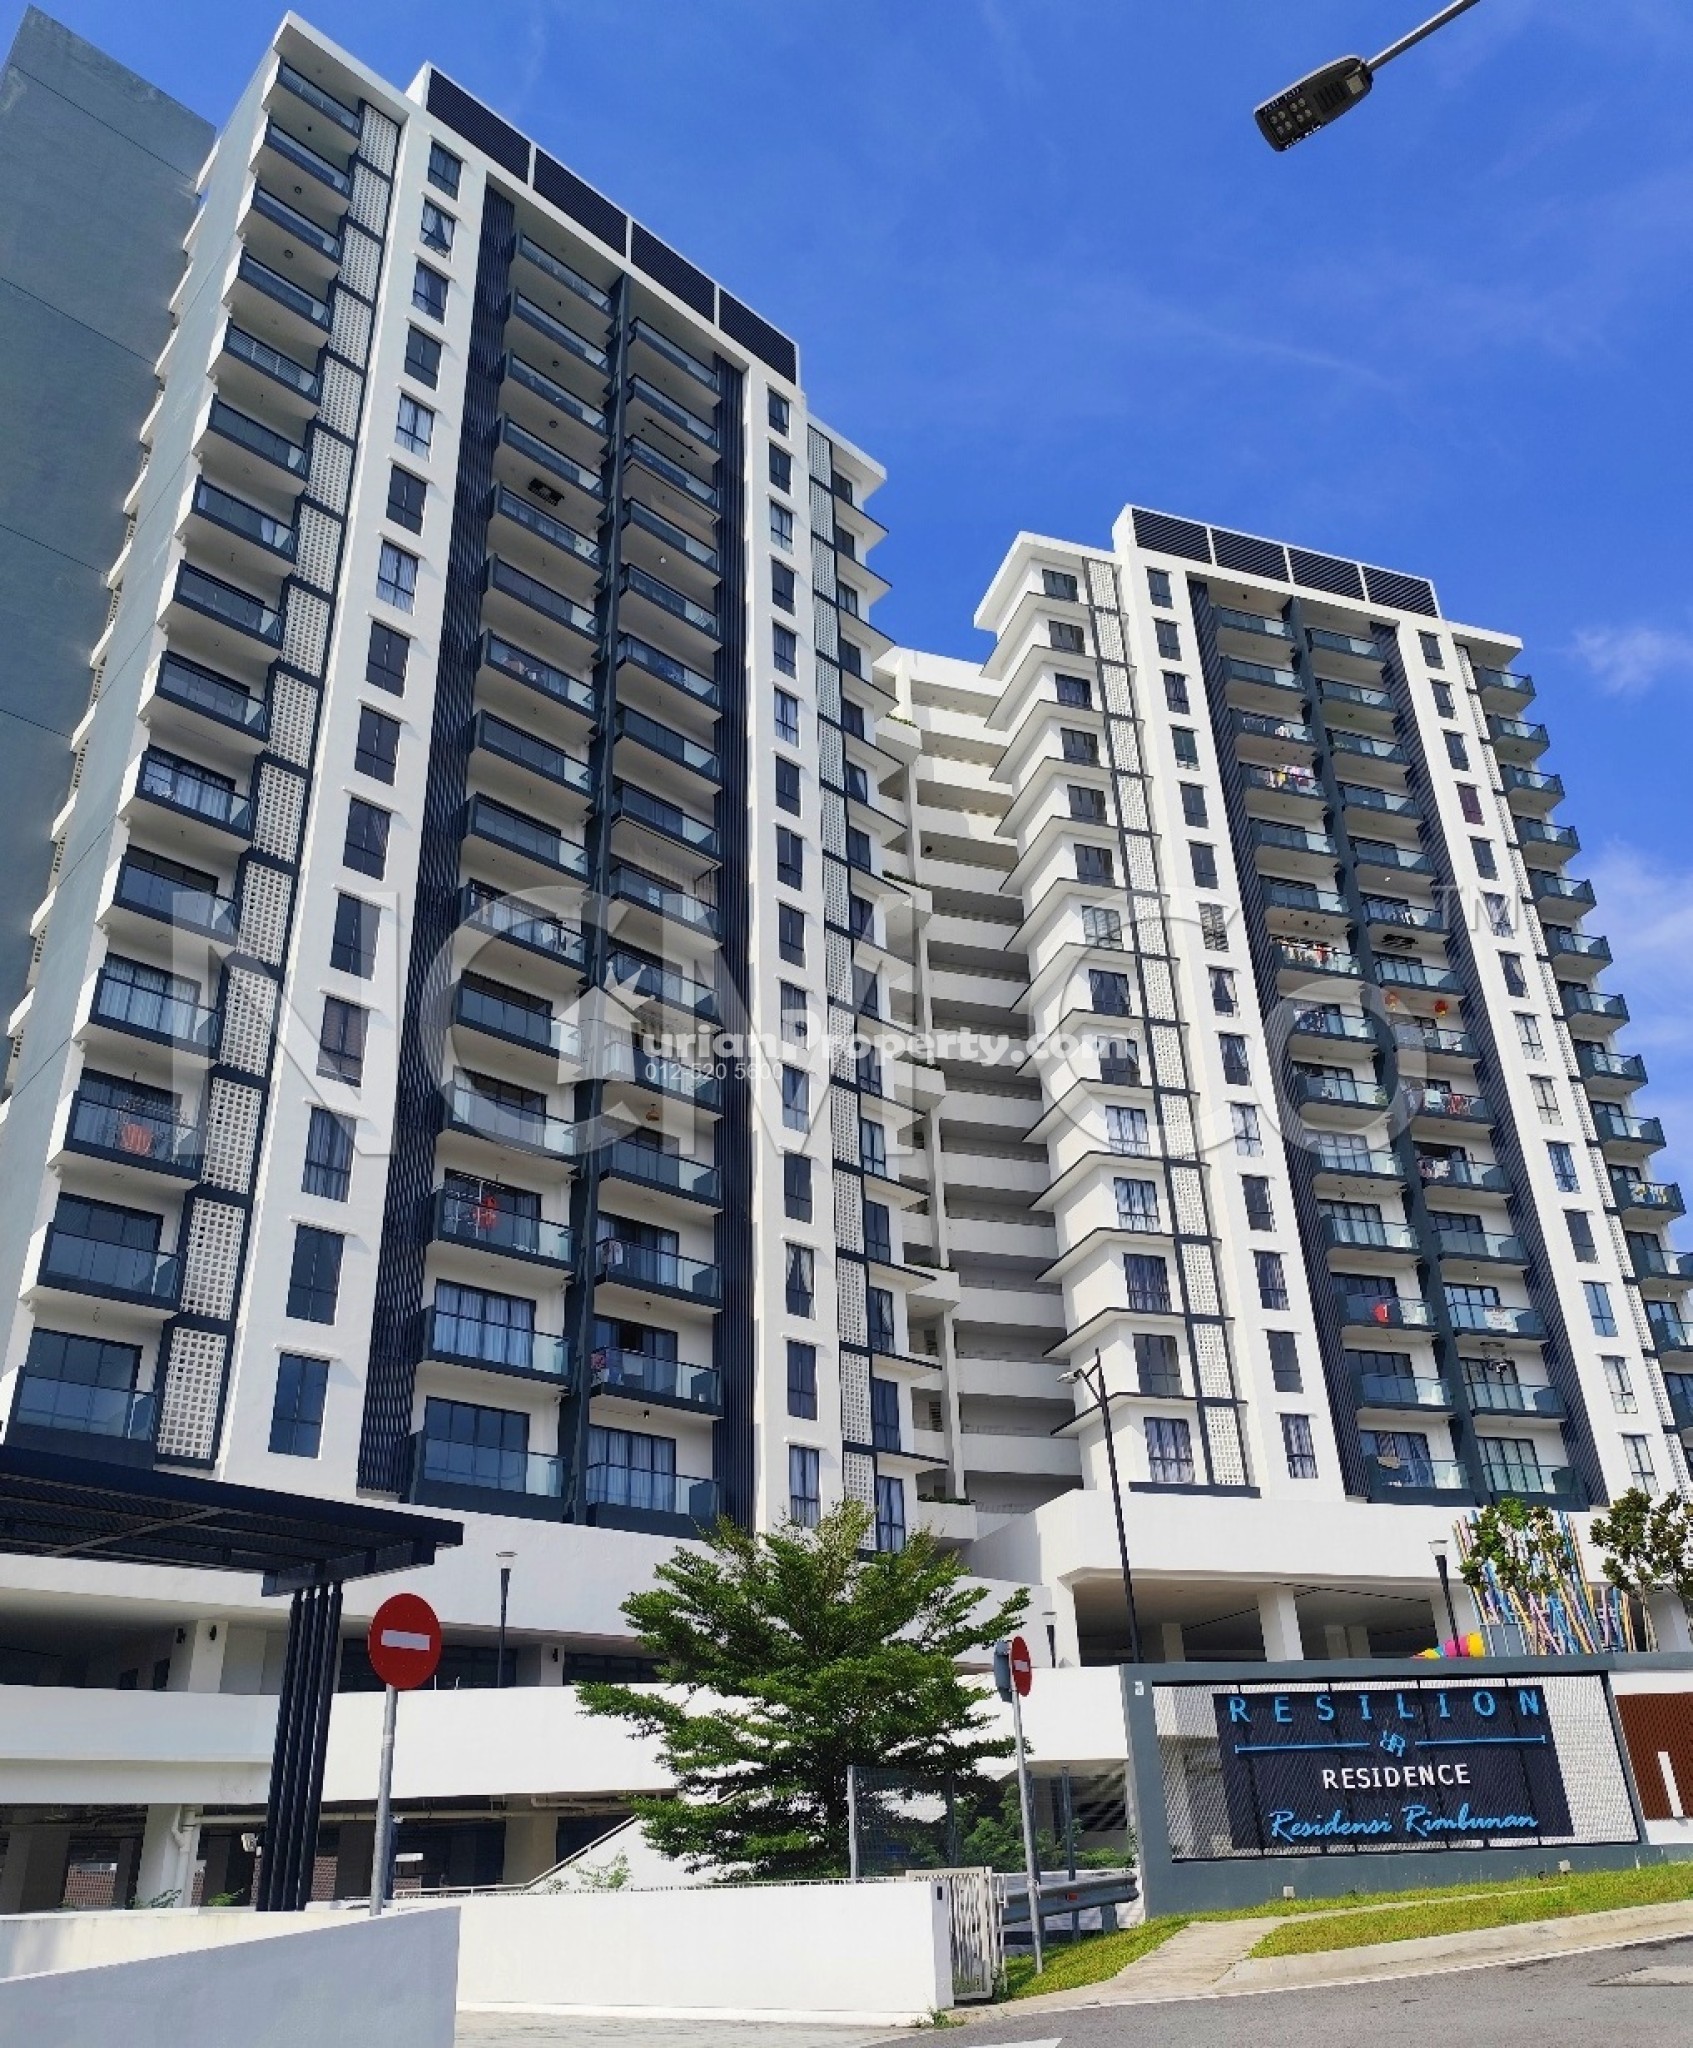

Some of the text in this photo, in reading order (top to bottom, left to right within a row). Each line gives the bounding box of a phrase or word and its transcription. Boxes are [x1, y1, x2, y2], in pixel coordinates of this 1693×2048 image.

[1229, 1690, 1540, 1723] RESILION
[1322, 1763, 1471, 1789] RESIDENCE
[1269, 1803, 1539, 1842] Residensi Rimbunan
